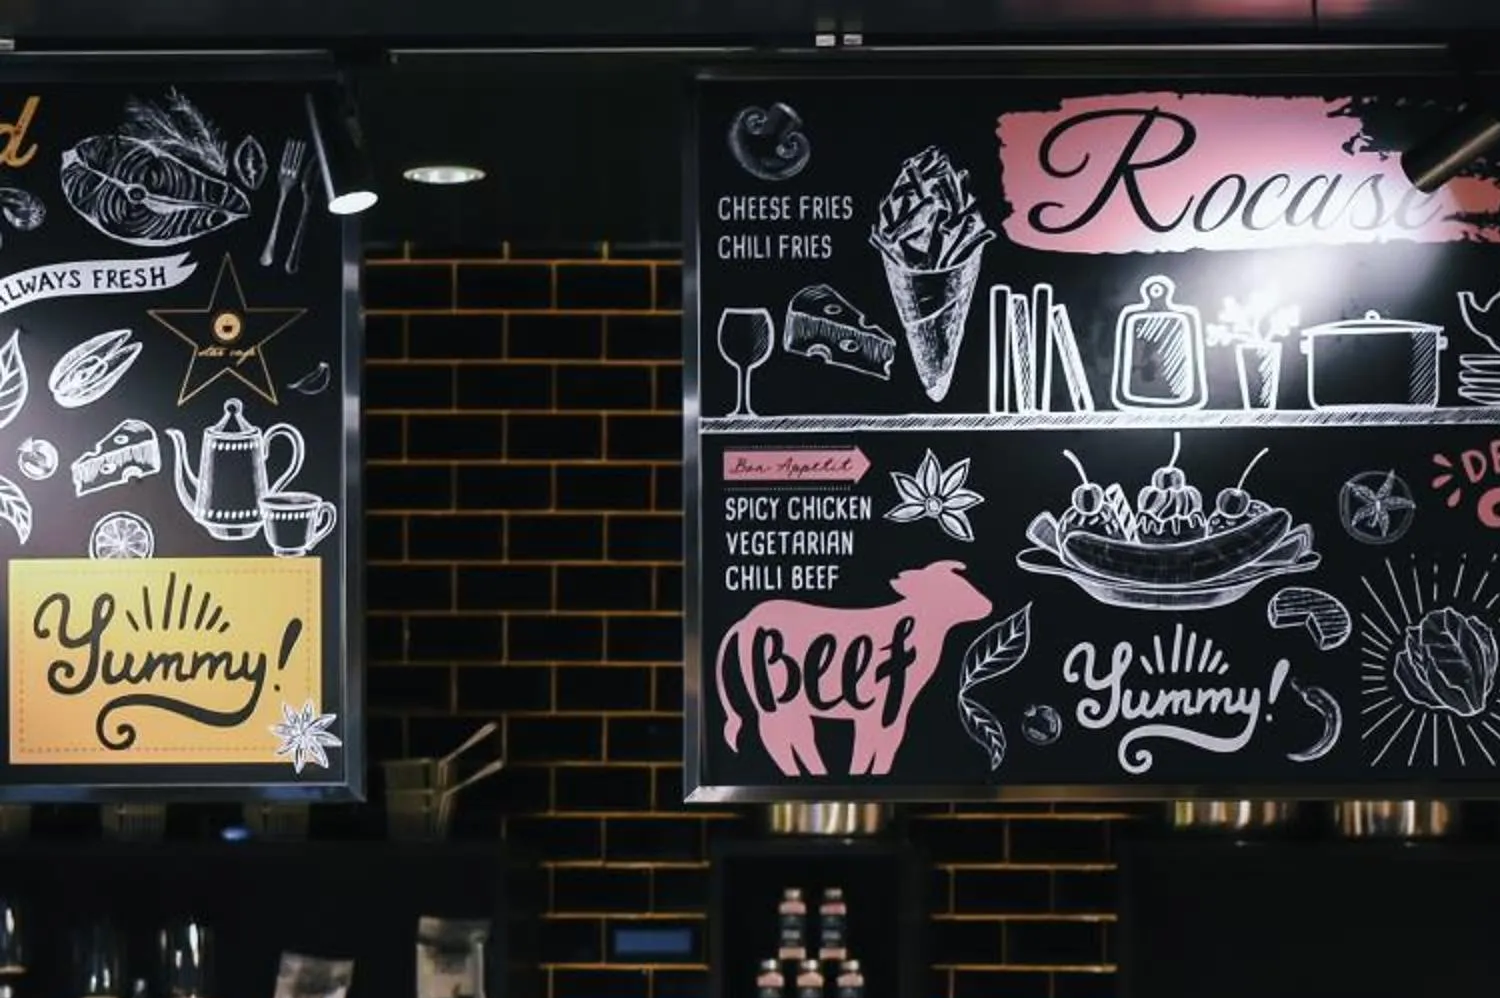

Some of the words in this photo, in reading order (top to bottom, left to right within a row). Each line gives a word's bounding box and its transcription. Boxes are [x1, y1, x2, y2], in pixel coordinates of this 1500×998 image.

[718, 195, 791, 221] CHEESE
[800, 195, 853, 220] FRIES
[718, 234, 771, 259] CHILI
[779, 234, 832, 259] FRIES
[93, 266, 166, 289] FRESH
[725, 496, 780, 521] SPICY
[787, 495, 872, 521] CHICKEN
[725, 529, 853, 556] VEGETARIAN
[725, 564, 782, 591] CHILI
[791, 564, 839, 590] BEEF
[33, 592, 303, 750] Yummy!
[752, 615, 917, 728] Beef
[1063, 641, 1290, 774] Yummy!
